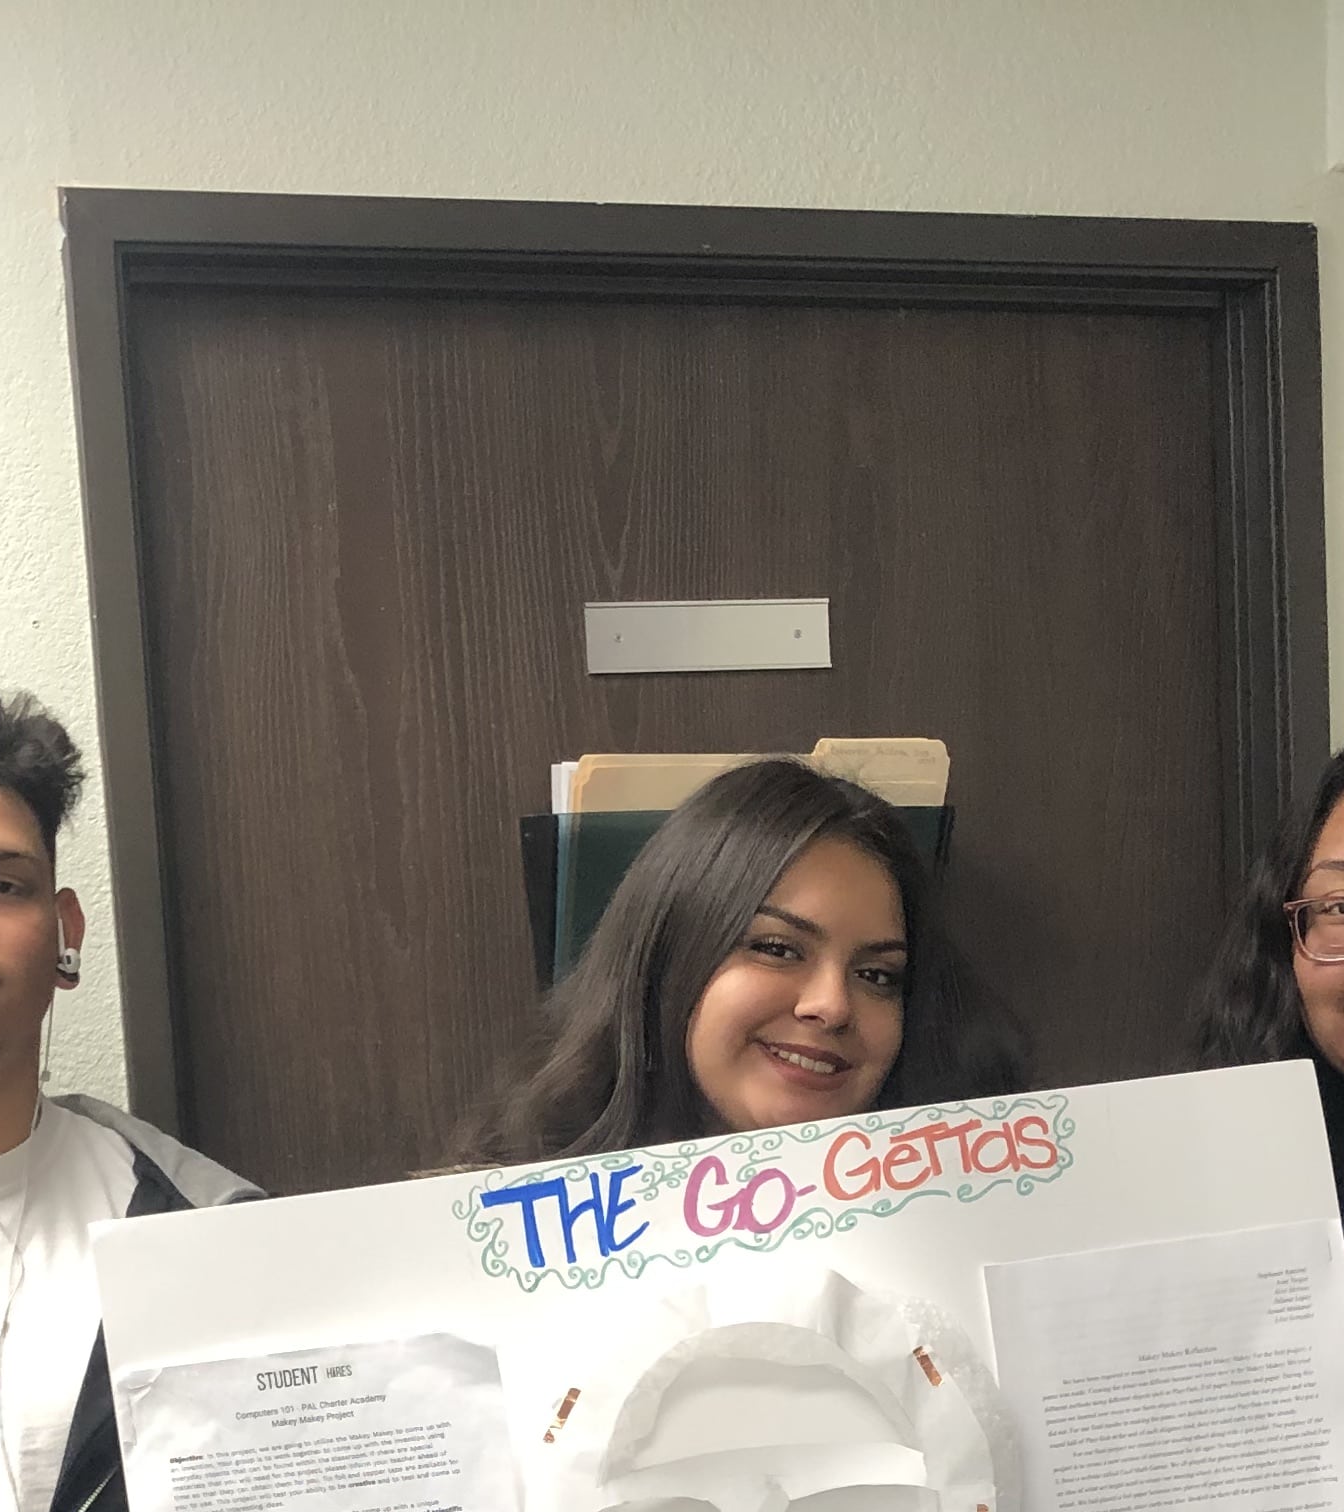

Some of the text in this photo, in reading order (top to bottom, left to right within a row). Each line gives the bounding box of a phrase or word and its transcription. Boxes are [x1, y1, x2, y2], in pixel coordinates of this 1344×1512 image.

[480, 1164, 650, 1268] THE
[256, 1366, 318, 1391] STUDENT
[235, 1393, 387, 1420] Computers 101 PAL Charter Academy
[271, 1410, 354, 1428] Makey Makey Project
